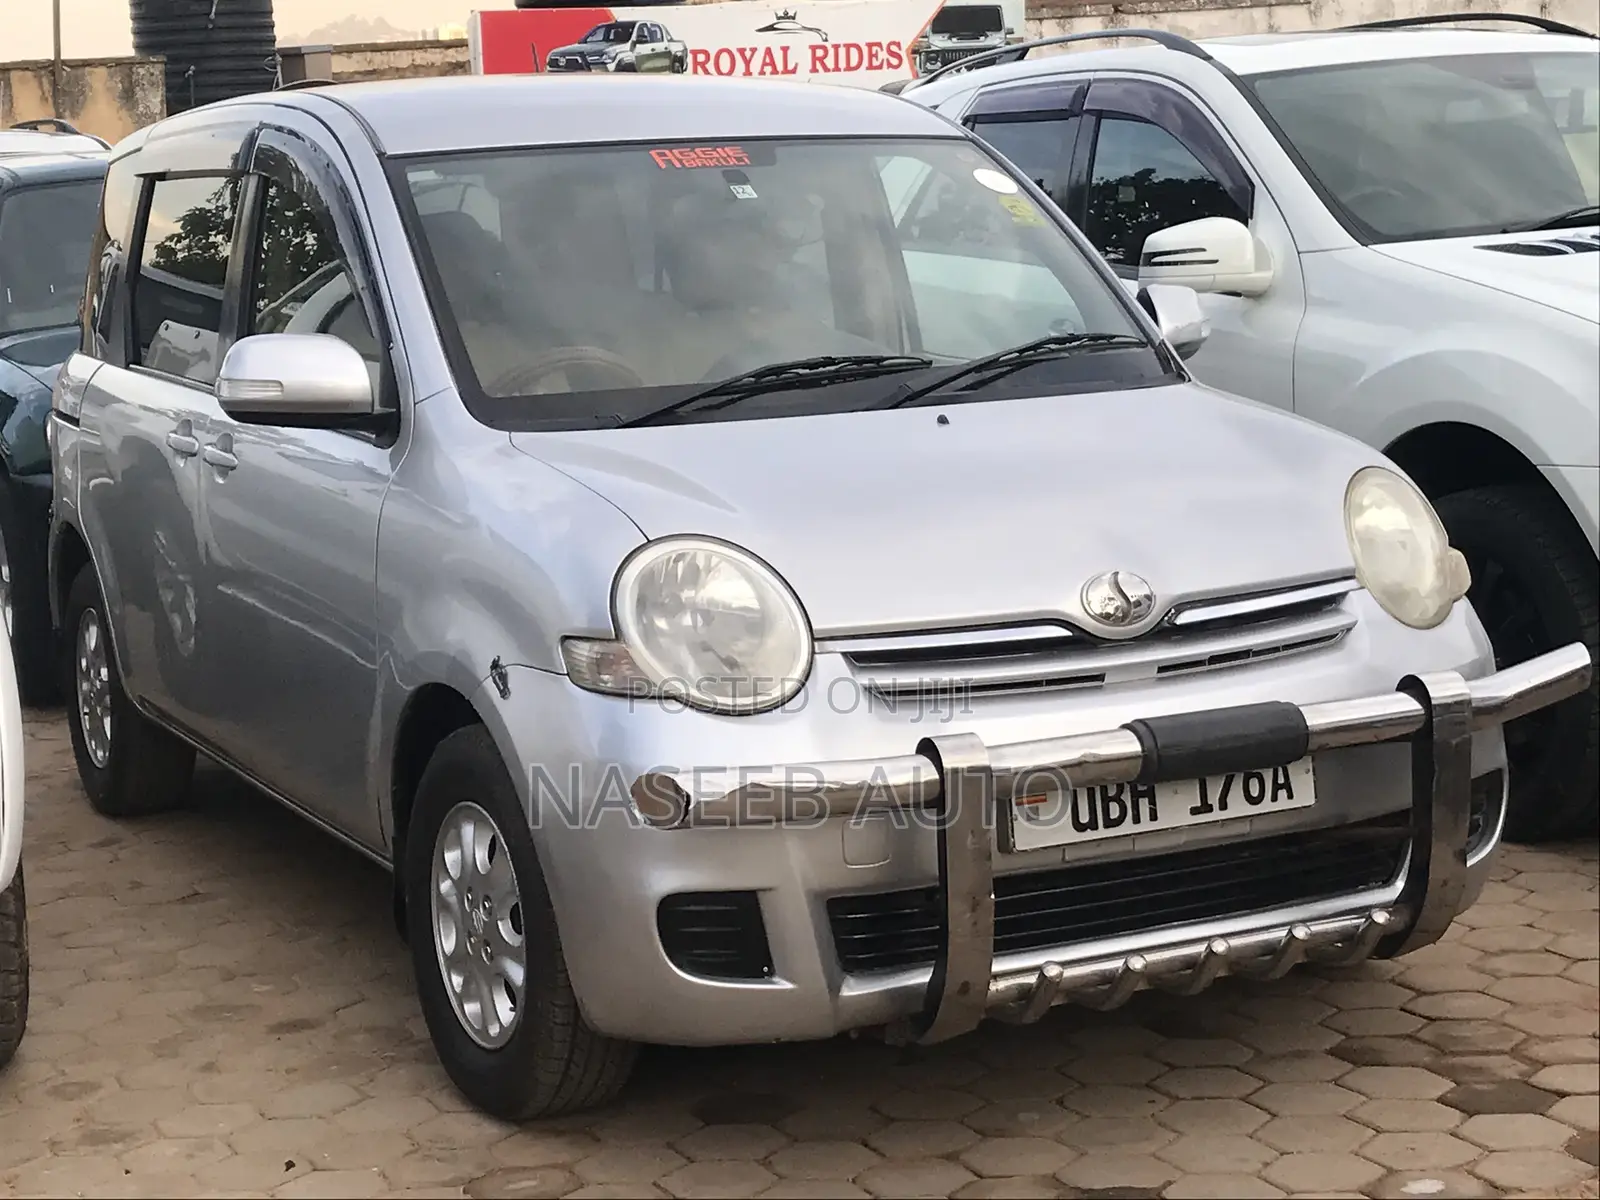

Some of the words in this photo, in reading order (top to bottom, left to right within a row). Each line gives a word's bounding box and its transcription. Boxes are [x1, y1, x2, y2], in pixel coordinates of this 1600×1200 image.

[689, 45, 799, 76] ROYAL
[808, 41, 903, 73] RIDES
[649, 146, 749, 169] AGGIE
